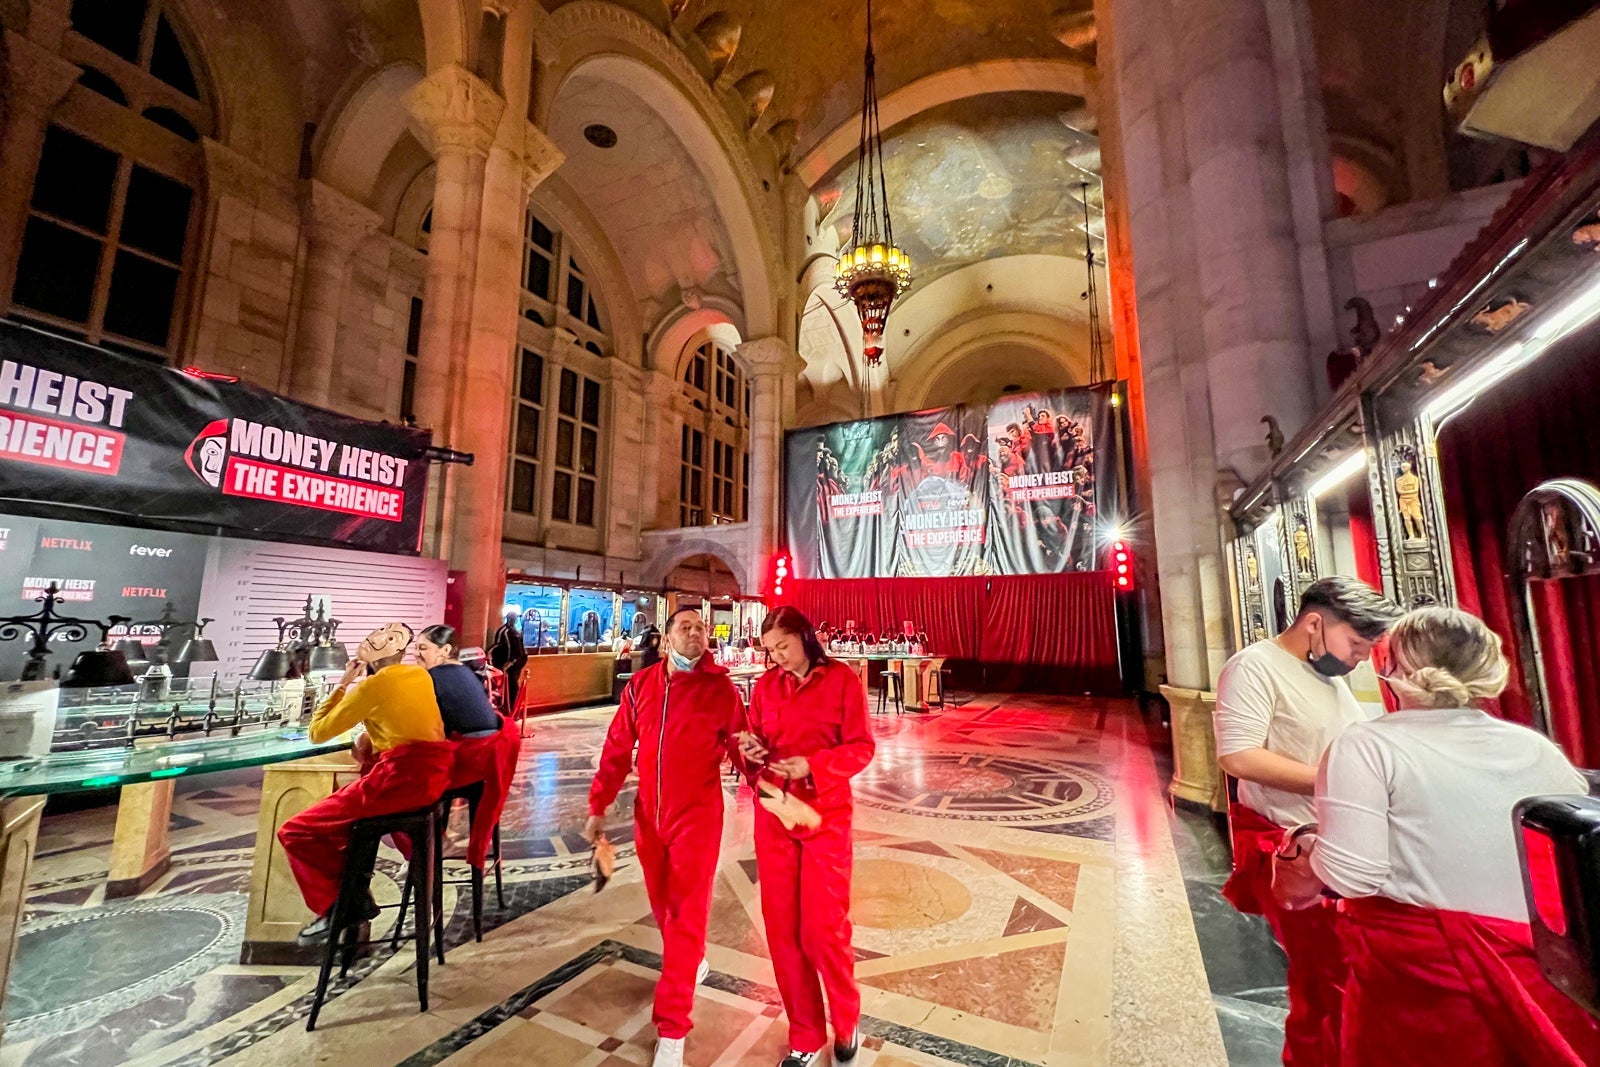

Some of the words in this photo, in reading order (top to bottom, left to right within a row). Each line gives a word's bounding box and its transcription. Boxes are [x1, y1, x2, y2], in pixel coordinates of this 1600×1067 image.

[0, 360, 133, 427] HEIST
[230, 418, 337, 472] MONEY
[339, 444, 408, 488] HEIST
[1009, 473, 1043, 488] MONEY
[1045, 470, 1074, 485] HEIST
[234, 462, 278, 496] THE
[282, 472, 400, 517] EXPERIENCE
[1012, 490, 1026, 500] THE
[1027, 486, 1073, 499] EXPERIENCE
[831, 493, 858, 506] MONEY
[860, 490, 882, 504] HEIST
[905, 511, 947, 530] MONEY
[949, 508, 984, 527] HEIST
[41, 536, 93, 551] NETFLIX
[908, 531, 925, 545] THE
[927, 528, 982, 544] EXPERIENCE
[130, 544, 173, 557] fever
[23, 576, 64, 589] MONY
[64, 579, 97, 590] HEIST
[122, 586, 167, 599] NETFLIX
